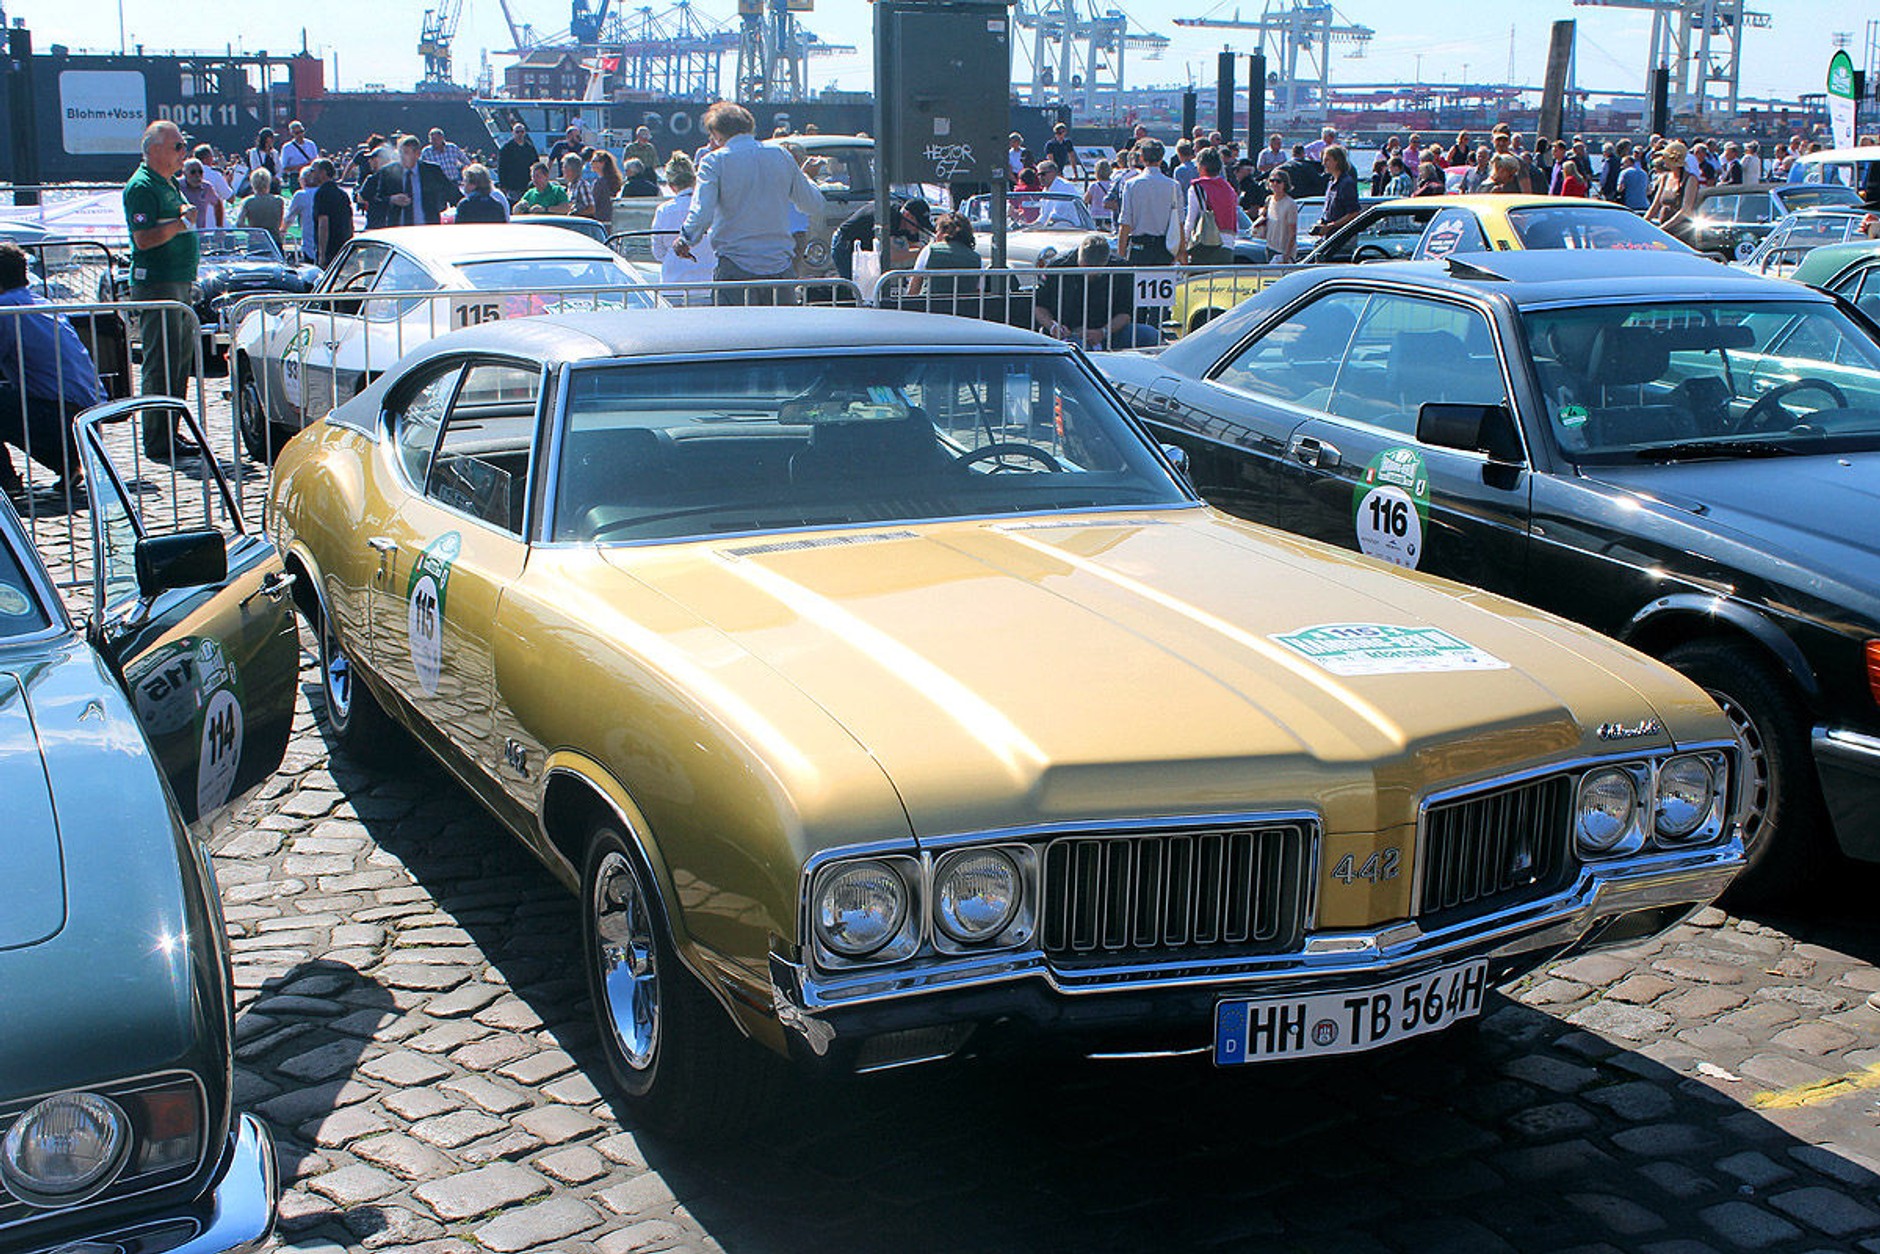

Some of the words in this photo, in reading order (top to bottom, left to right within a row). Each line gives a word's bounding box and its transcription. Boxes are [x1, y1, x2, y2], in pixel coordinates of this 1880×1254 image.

[67, 107, 144, 119] Blohm+Voss
[158, 104, 213, 126] DOCK
[219, 104, 237, 126] 11
[1137, 279, 1173, 299] 116
[456, 303, 500, 328] 115
[1369, 495, 1408, 538] 116
[415, 589, 437, 640] 115
[208, 702, 236, 767] 114
[1330, 847, 1401, 885] 442
[1226, 1039, 1237, 1054] D
[1249, 1003, 1306, 1055] HH
[1344, 993, 1393, 1046] TB
[1401, 965, 1486, 1031] 564H
